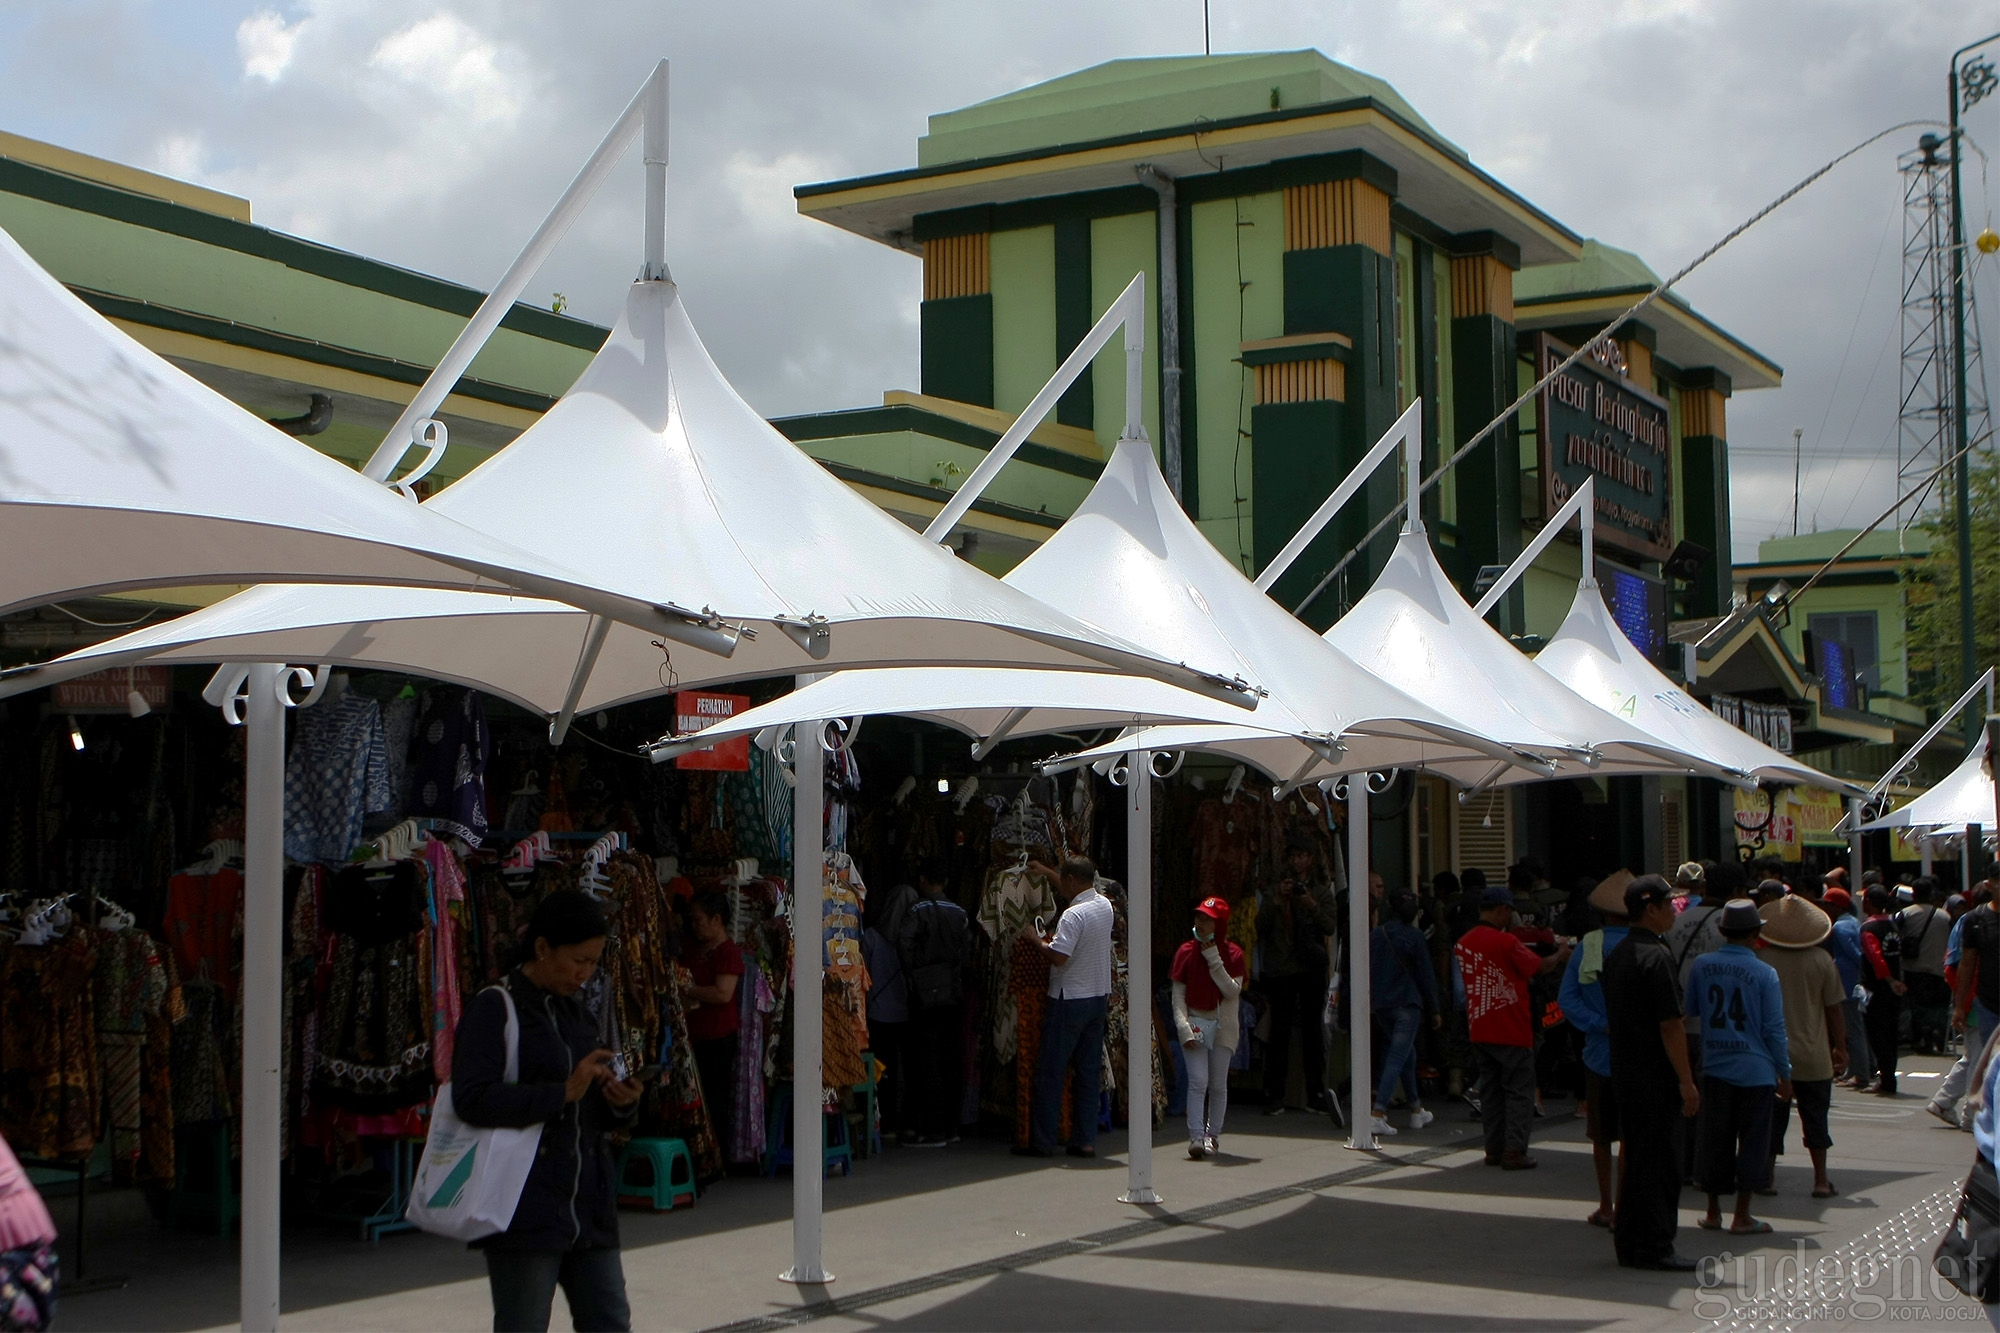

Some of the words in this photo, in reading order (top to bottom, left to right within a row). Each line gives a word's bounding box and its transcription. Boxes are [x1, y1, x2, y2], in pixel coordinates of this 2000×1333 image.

[1549, 354, 1589, 412] Pasar
[1595, 381, 1665, 454] Beringharjo
[61, 685, 106, 703] WIDYA
[697, 697, 733, 715] PERHATIAN
[1708, 984, 1748, 1032] 24
